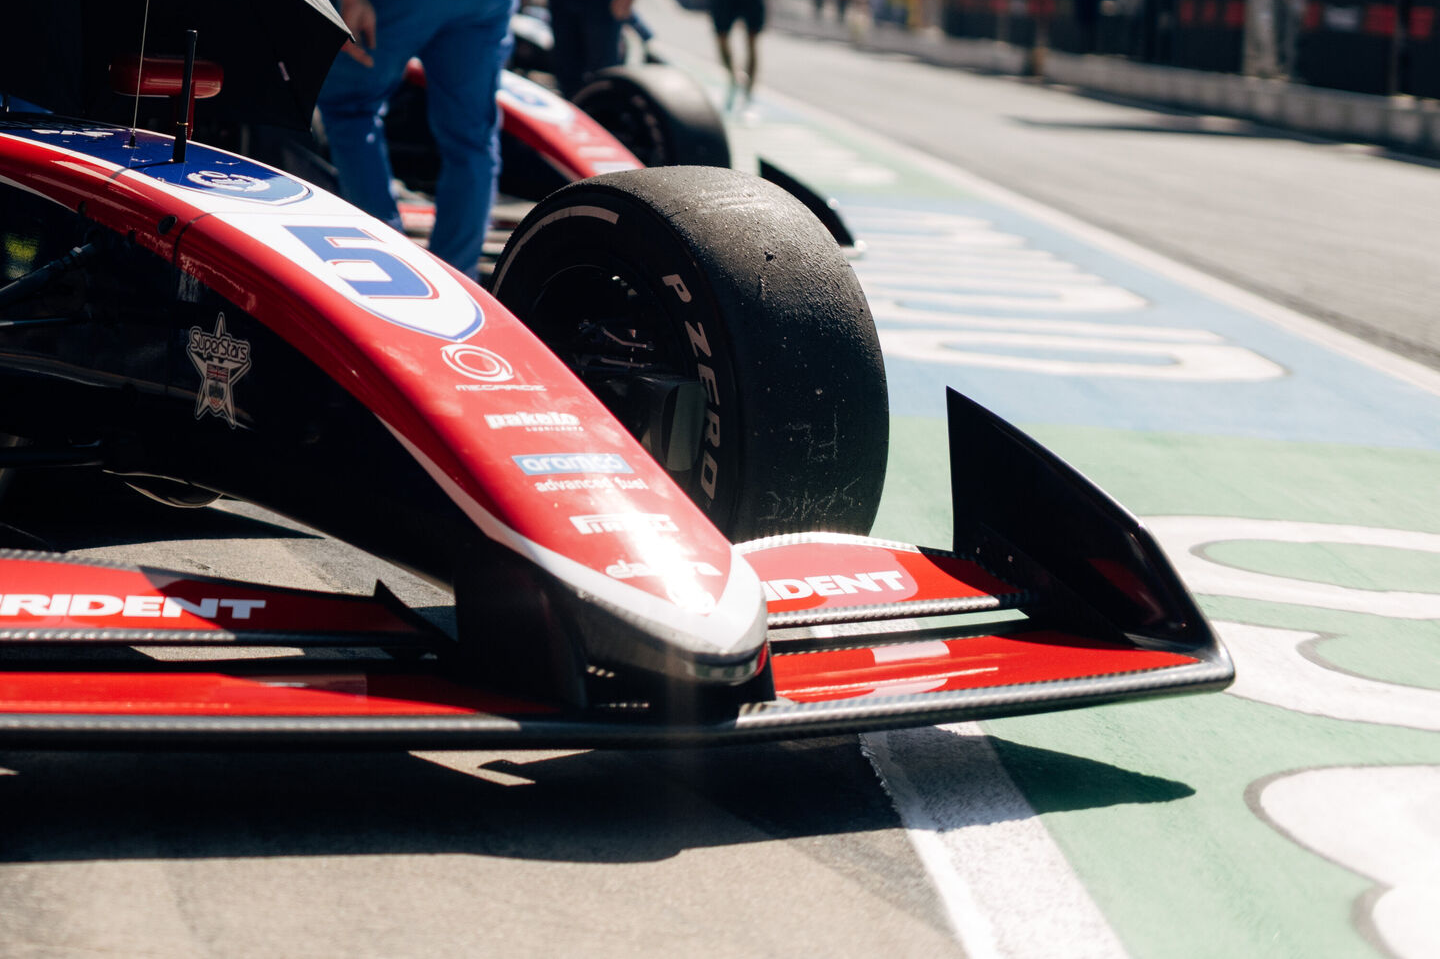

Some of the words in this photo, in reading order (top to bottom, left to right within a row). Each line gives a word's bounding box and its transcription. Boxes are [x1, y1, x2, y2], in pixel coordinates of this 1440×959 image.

[283, 225, 440, 299] 5
[484, 411, 581, 430] pakelo
[684, 321, 721, 500] ZERO
[534, 476, 614, 492] advanced
[759, 569, 905, 602] IDENT
